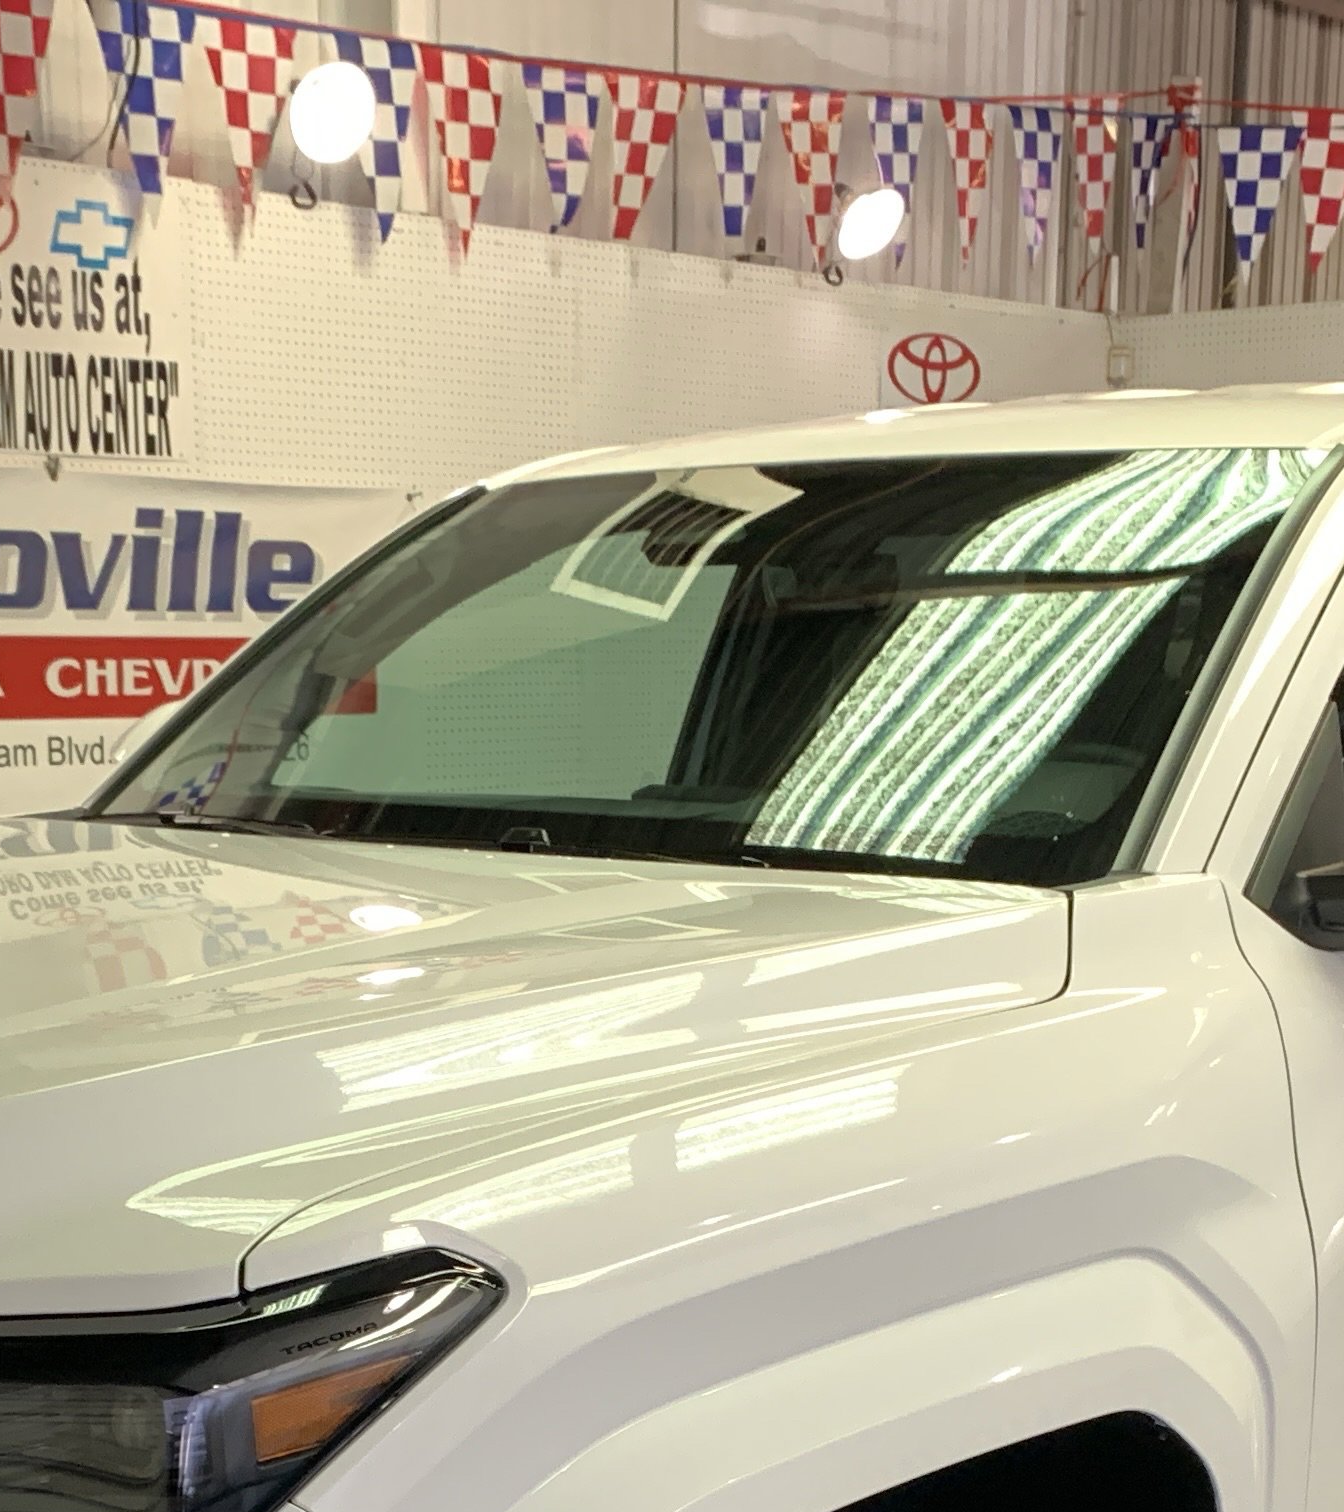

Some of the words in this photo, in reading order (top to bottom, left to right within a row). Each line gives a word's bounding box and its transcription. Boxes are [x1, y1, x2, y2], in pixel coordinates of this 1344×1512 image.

[10, 262, 63, 331] see
[71, 268, 105, 333] us
[114, 255, 151, 356] at,
[24, 350, 80, 453] AUTO
[86, 354, 180, 457] CENTER"
[47, 735, 113, 767] Blvd.
[279, 1320, 380, 1356] TACOMA
